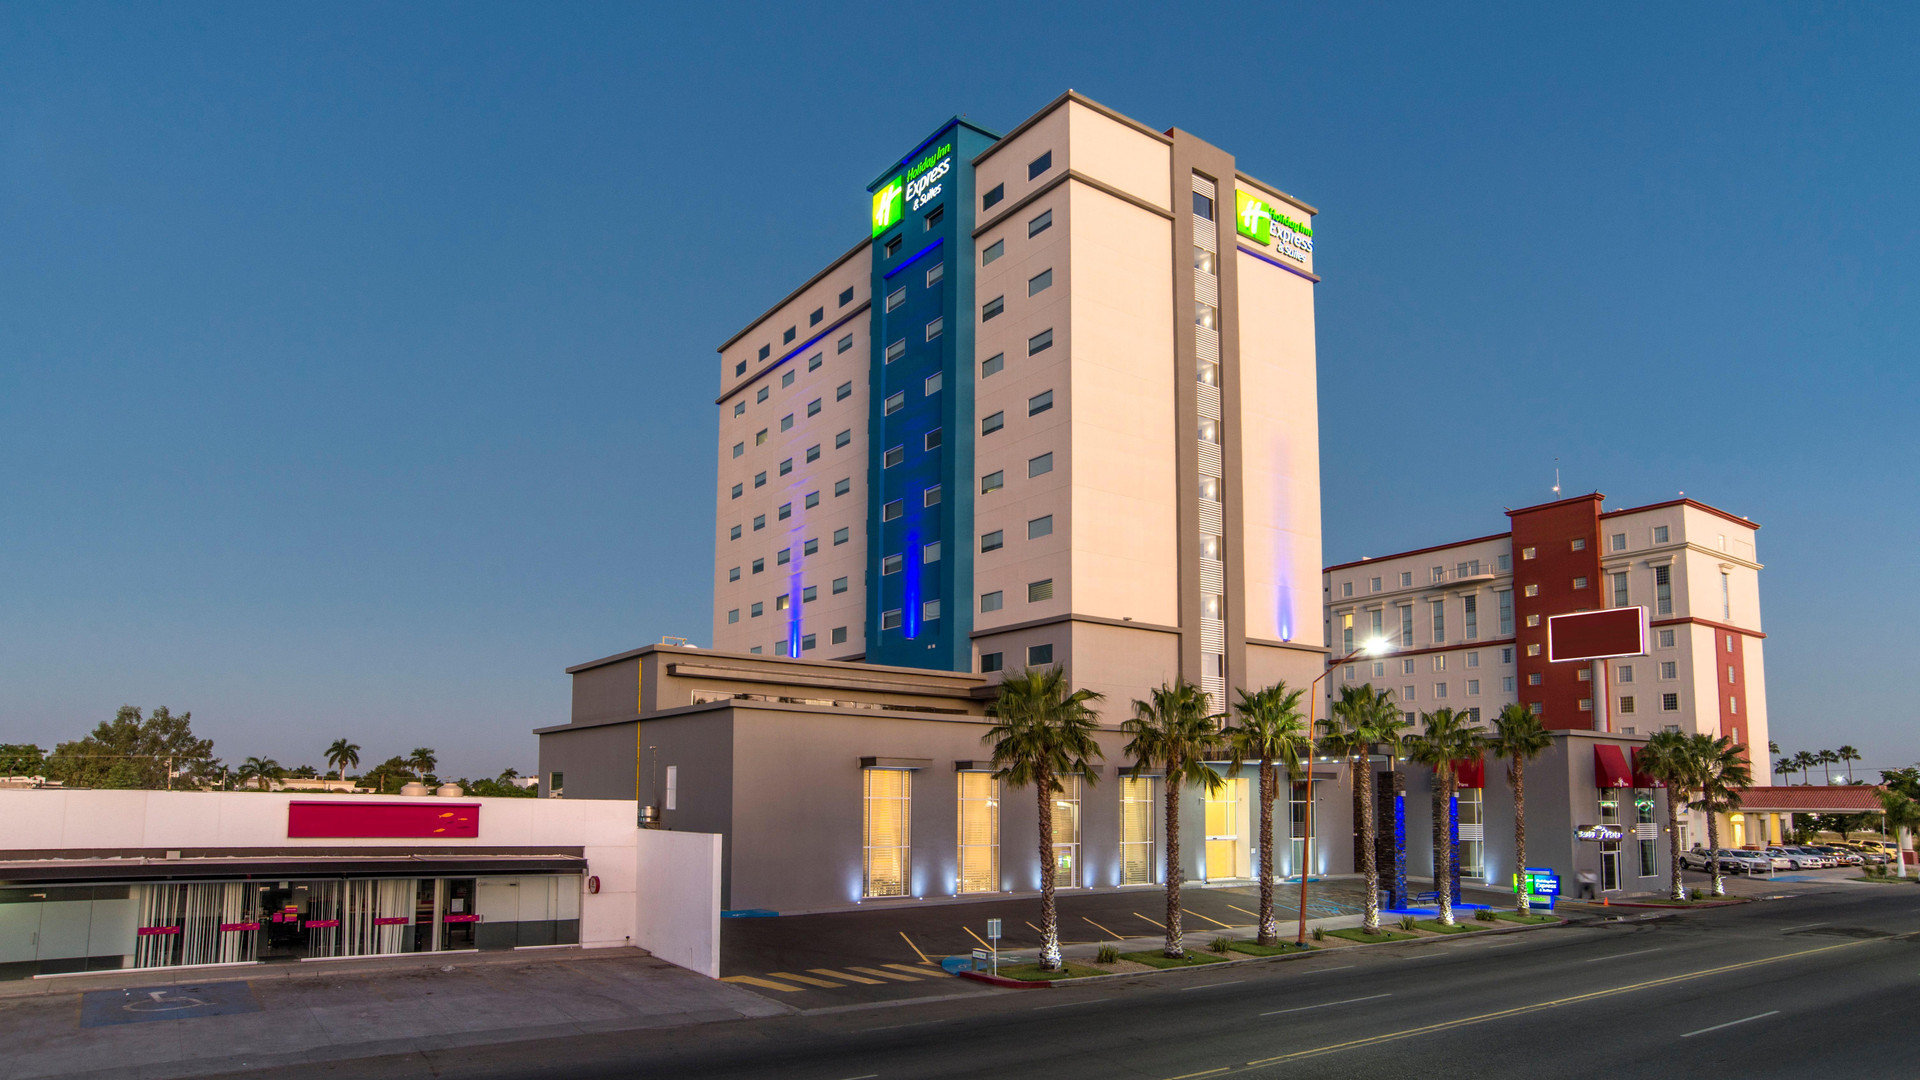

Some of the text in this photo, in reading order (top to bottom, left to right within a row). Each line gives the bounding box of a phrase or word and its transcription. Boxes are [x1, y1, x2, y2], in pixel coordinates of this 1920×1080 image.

[905, 157, 951, 201] Express
[907, 143, 951, 183] Holiday Inn
[913, 183, 942, 211] & Suites
[1269, 207, 1313, 237] Holiday Inn
[1269, 219, 1314, 253] Express
[1277, 242, 1307, 263] & Suites
